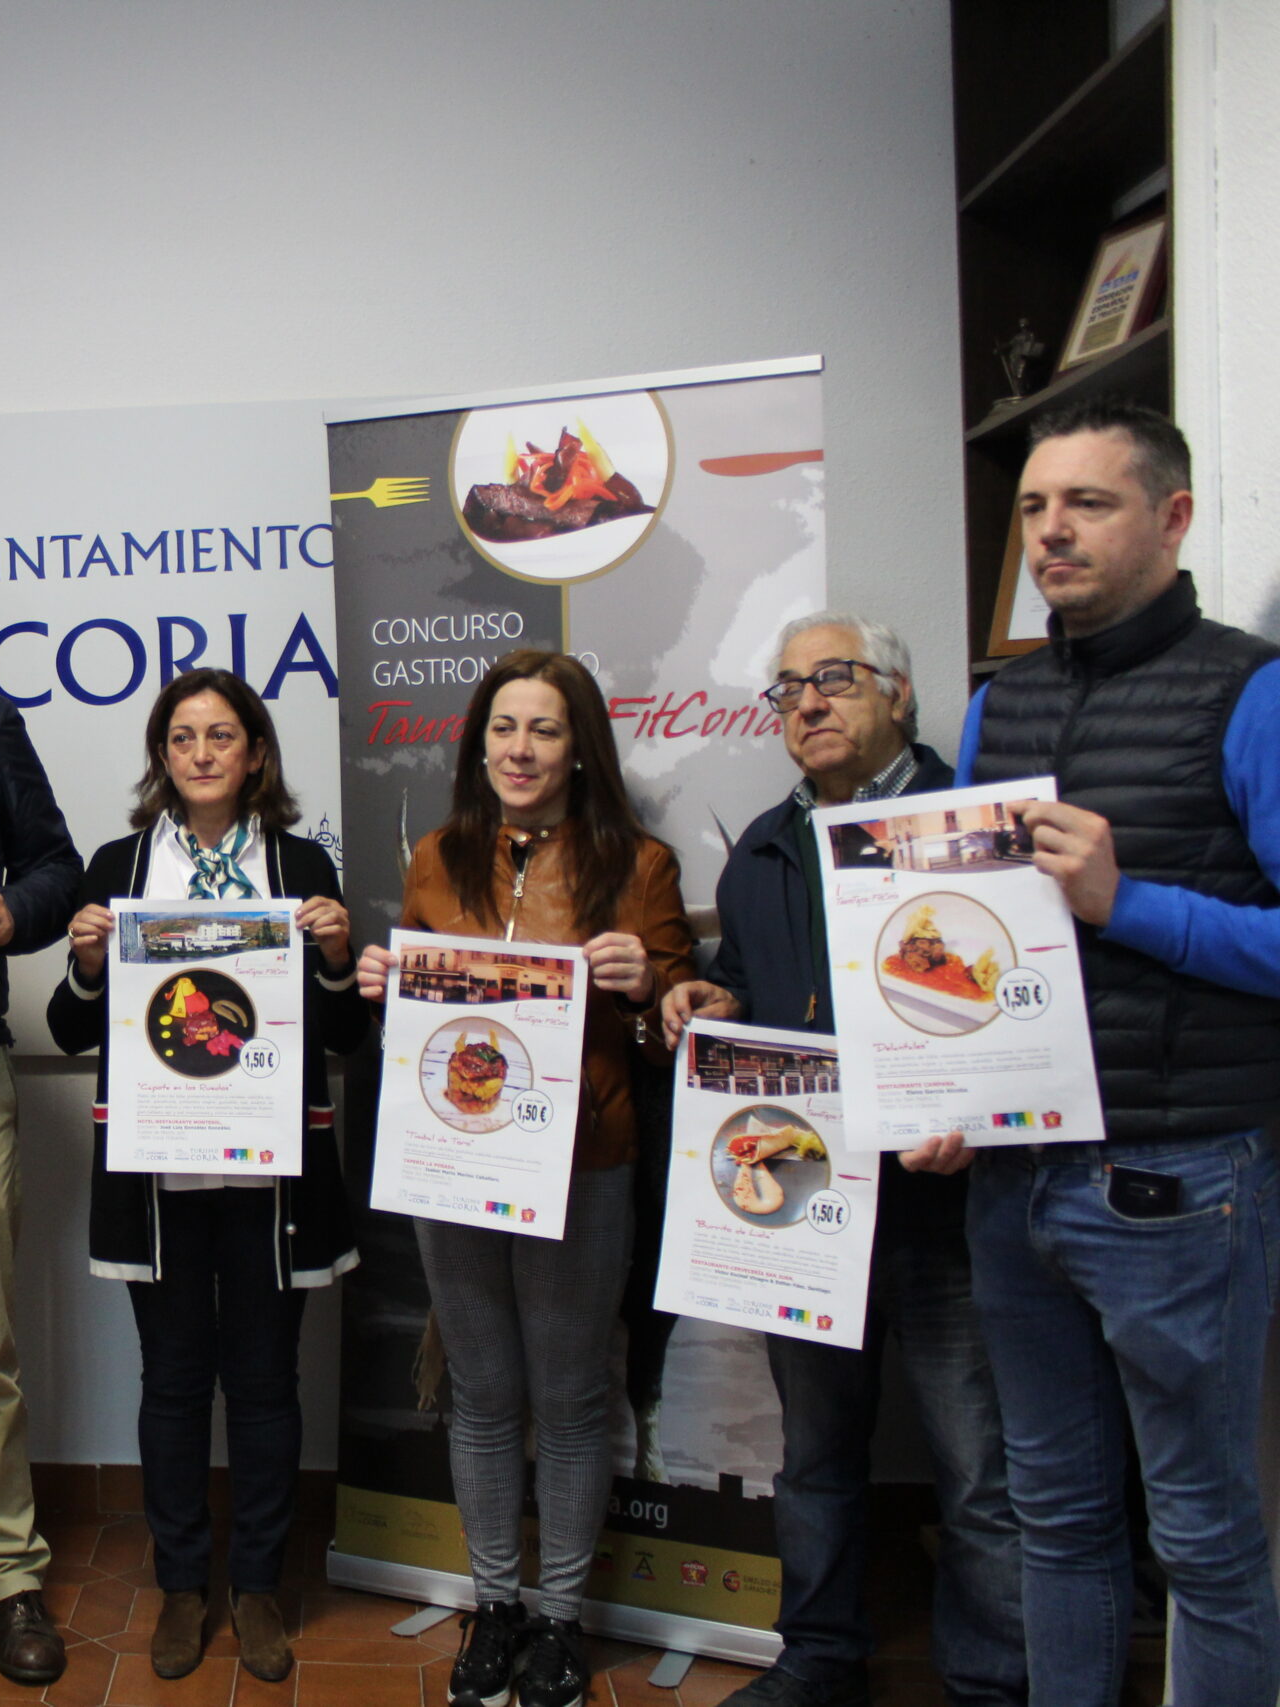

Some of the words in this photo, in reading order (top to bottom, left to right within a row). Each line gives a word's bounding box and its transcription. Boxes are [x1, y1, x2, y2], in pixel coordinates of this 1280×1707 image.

[373, 612, 523, 645] CONCURSO
[608, 690, 783, 739] FitCoria
[1003, 986, 1029, 1010] 1,50
[1034, 985, 1042, 1005] €
[245, 1052, 265, 1071] 1,50
[268, 1052, 273, 1068] €
[517, 1103, 538, 1123] 1,50
[540, 1106, 547, 1122] €
[811, 1202, 833, 1223] 1,50
[836, 1206, 843, 1224] €
